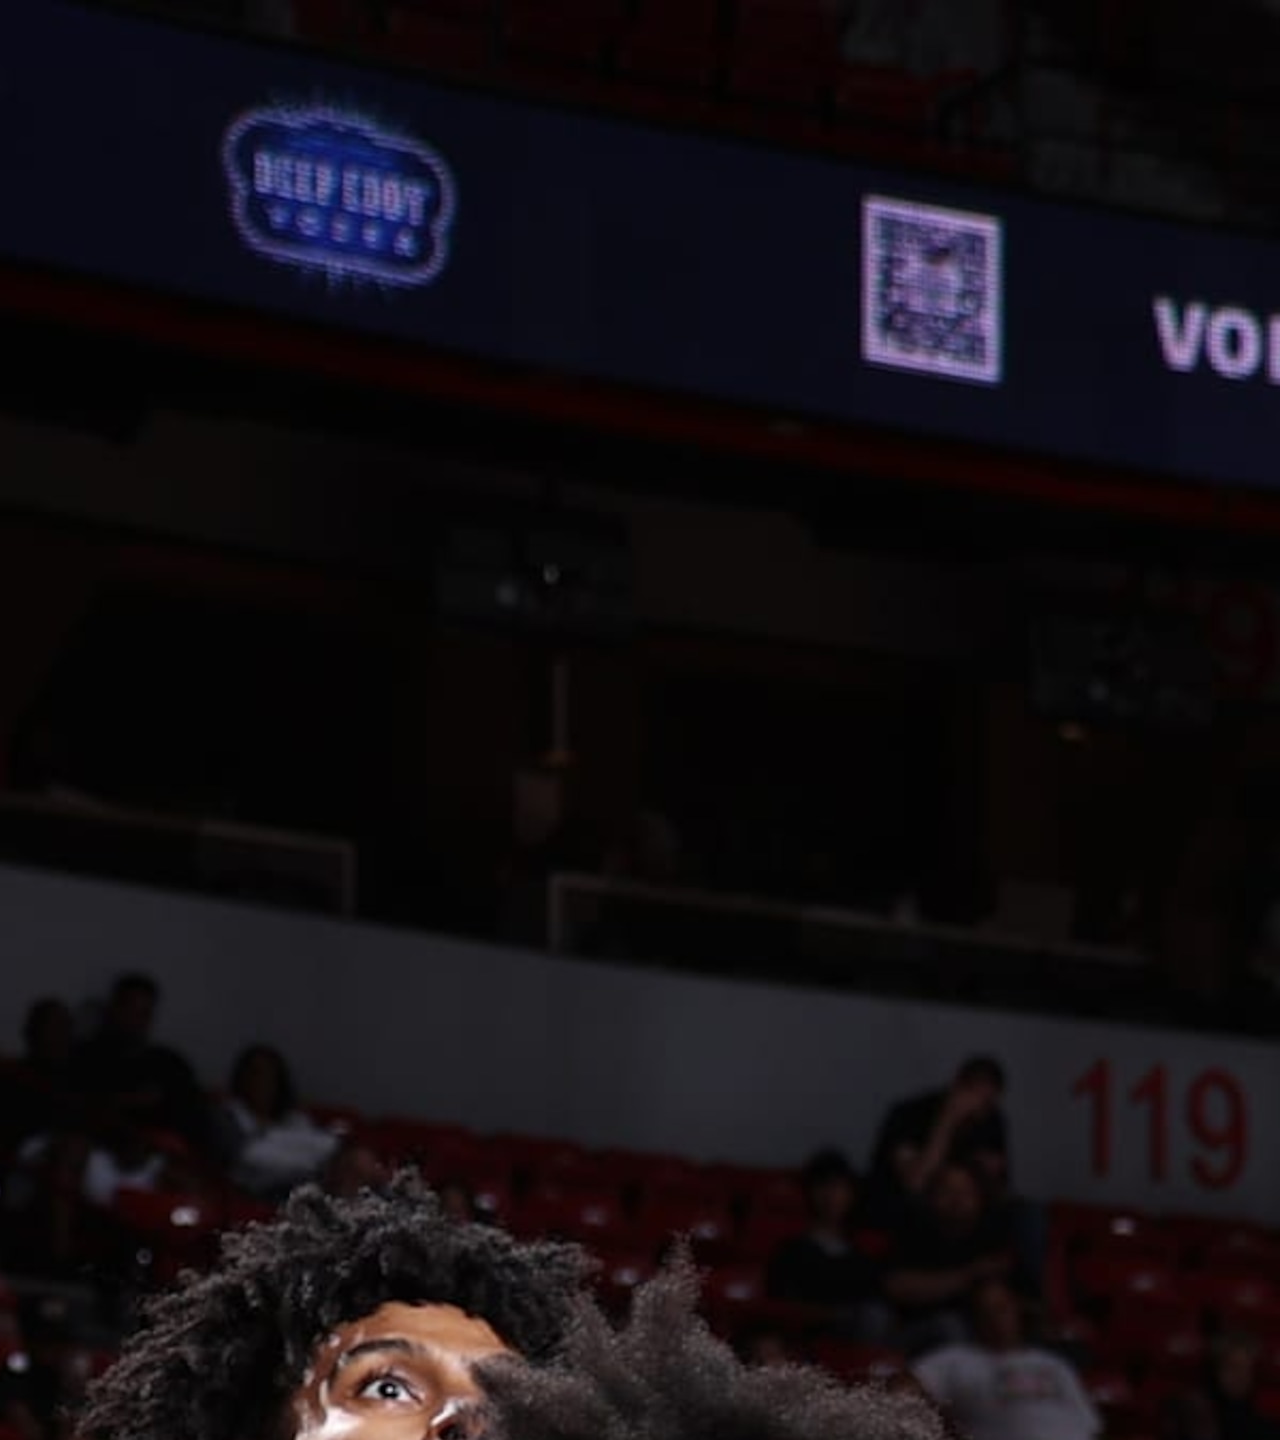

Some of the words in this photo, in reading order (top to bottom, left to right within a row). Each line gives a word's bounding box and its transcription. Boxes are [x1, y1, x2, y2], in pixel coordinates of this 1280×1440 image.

[253, 150, 334, 206] DEEP
[342, 166, 431, 227] EDDY
[1073, 1056, 1250, 1190] 119
